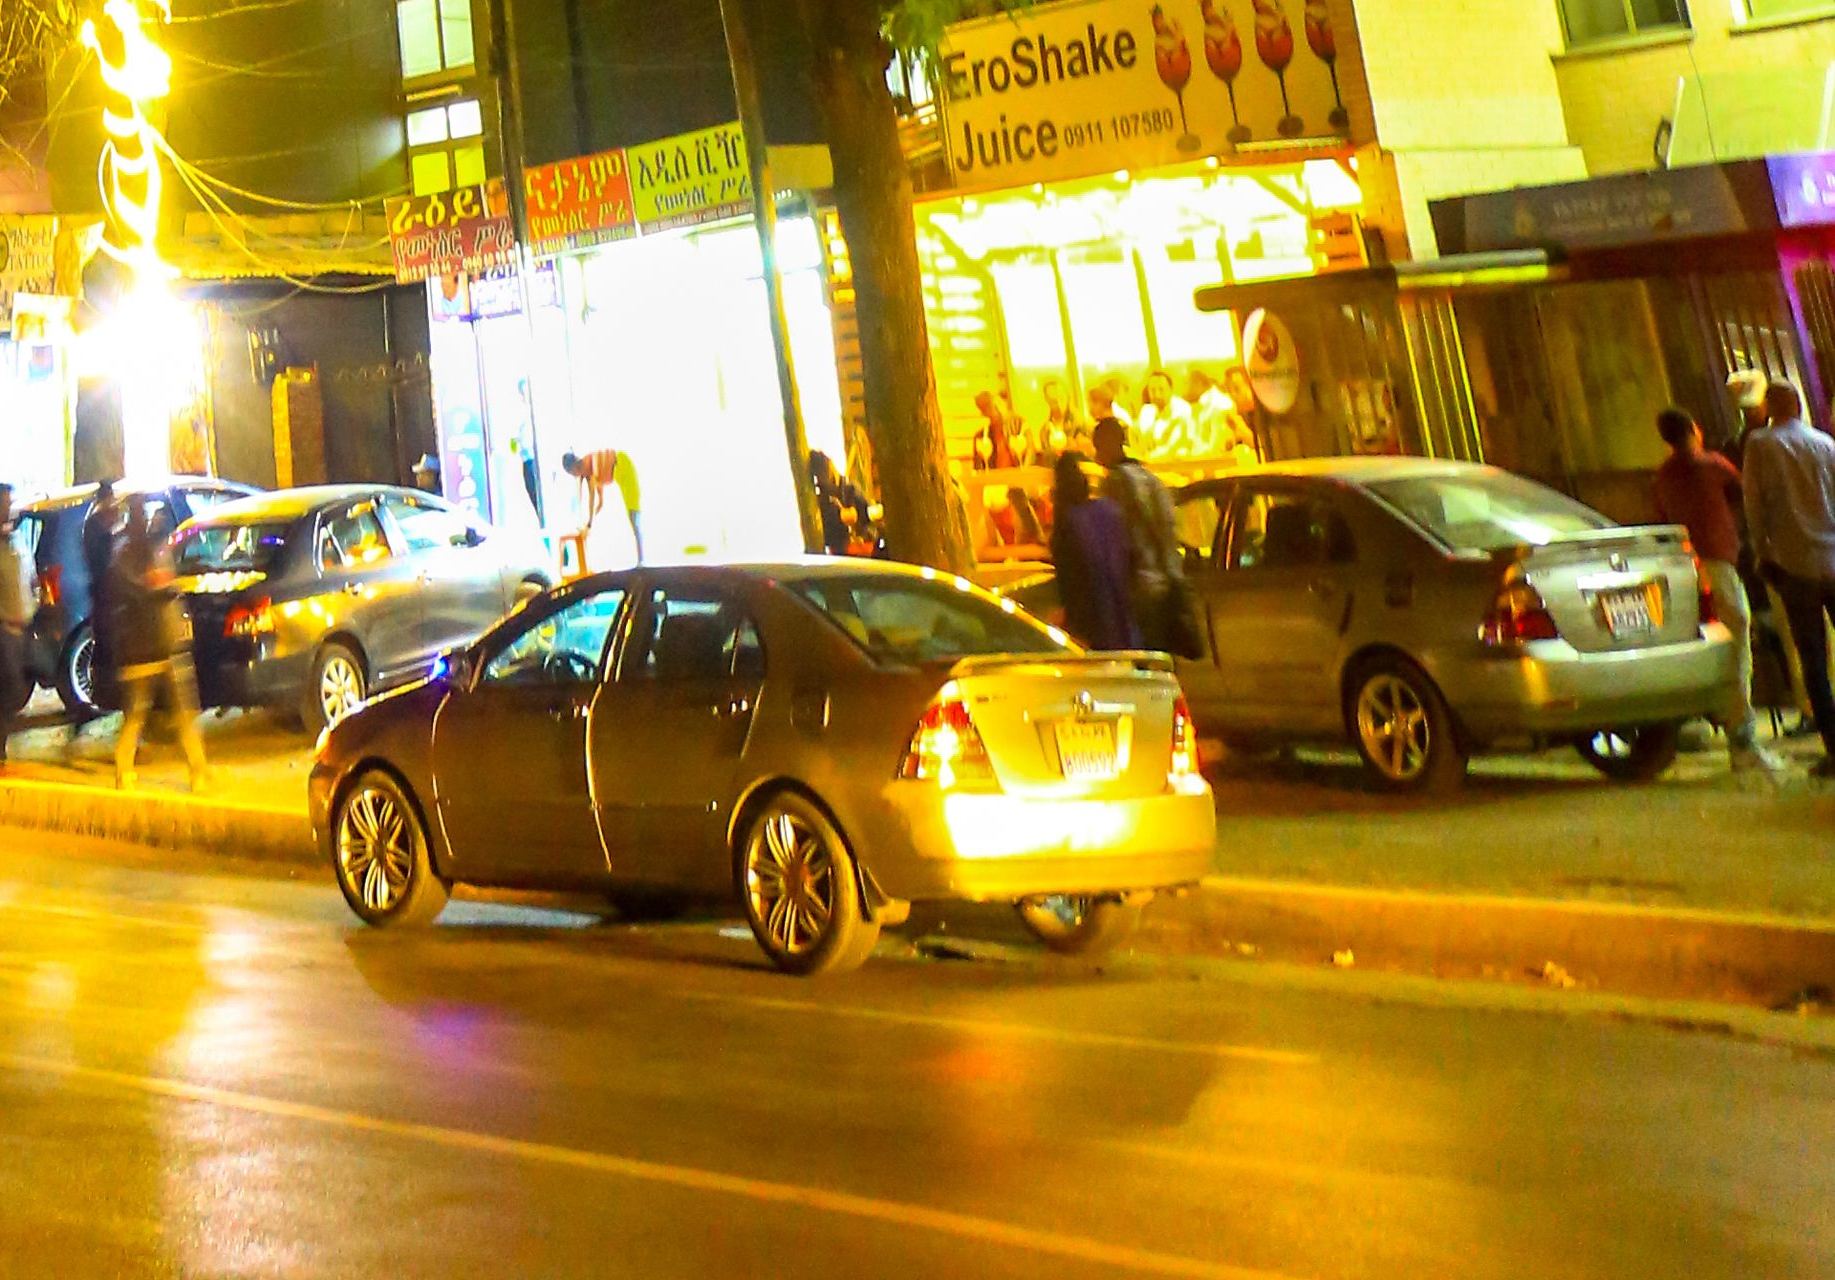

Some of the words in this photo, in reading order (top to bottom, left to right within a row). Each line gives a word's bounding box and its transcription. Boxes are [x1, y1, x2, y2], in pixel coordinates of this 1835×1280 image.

[943, 22, 1137, 104] EroShake
[956, 115, 1059, 173] Juice
[1064, 121, 1103, 148] 0911
